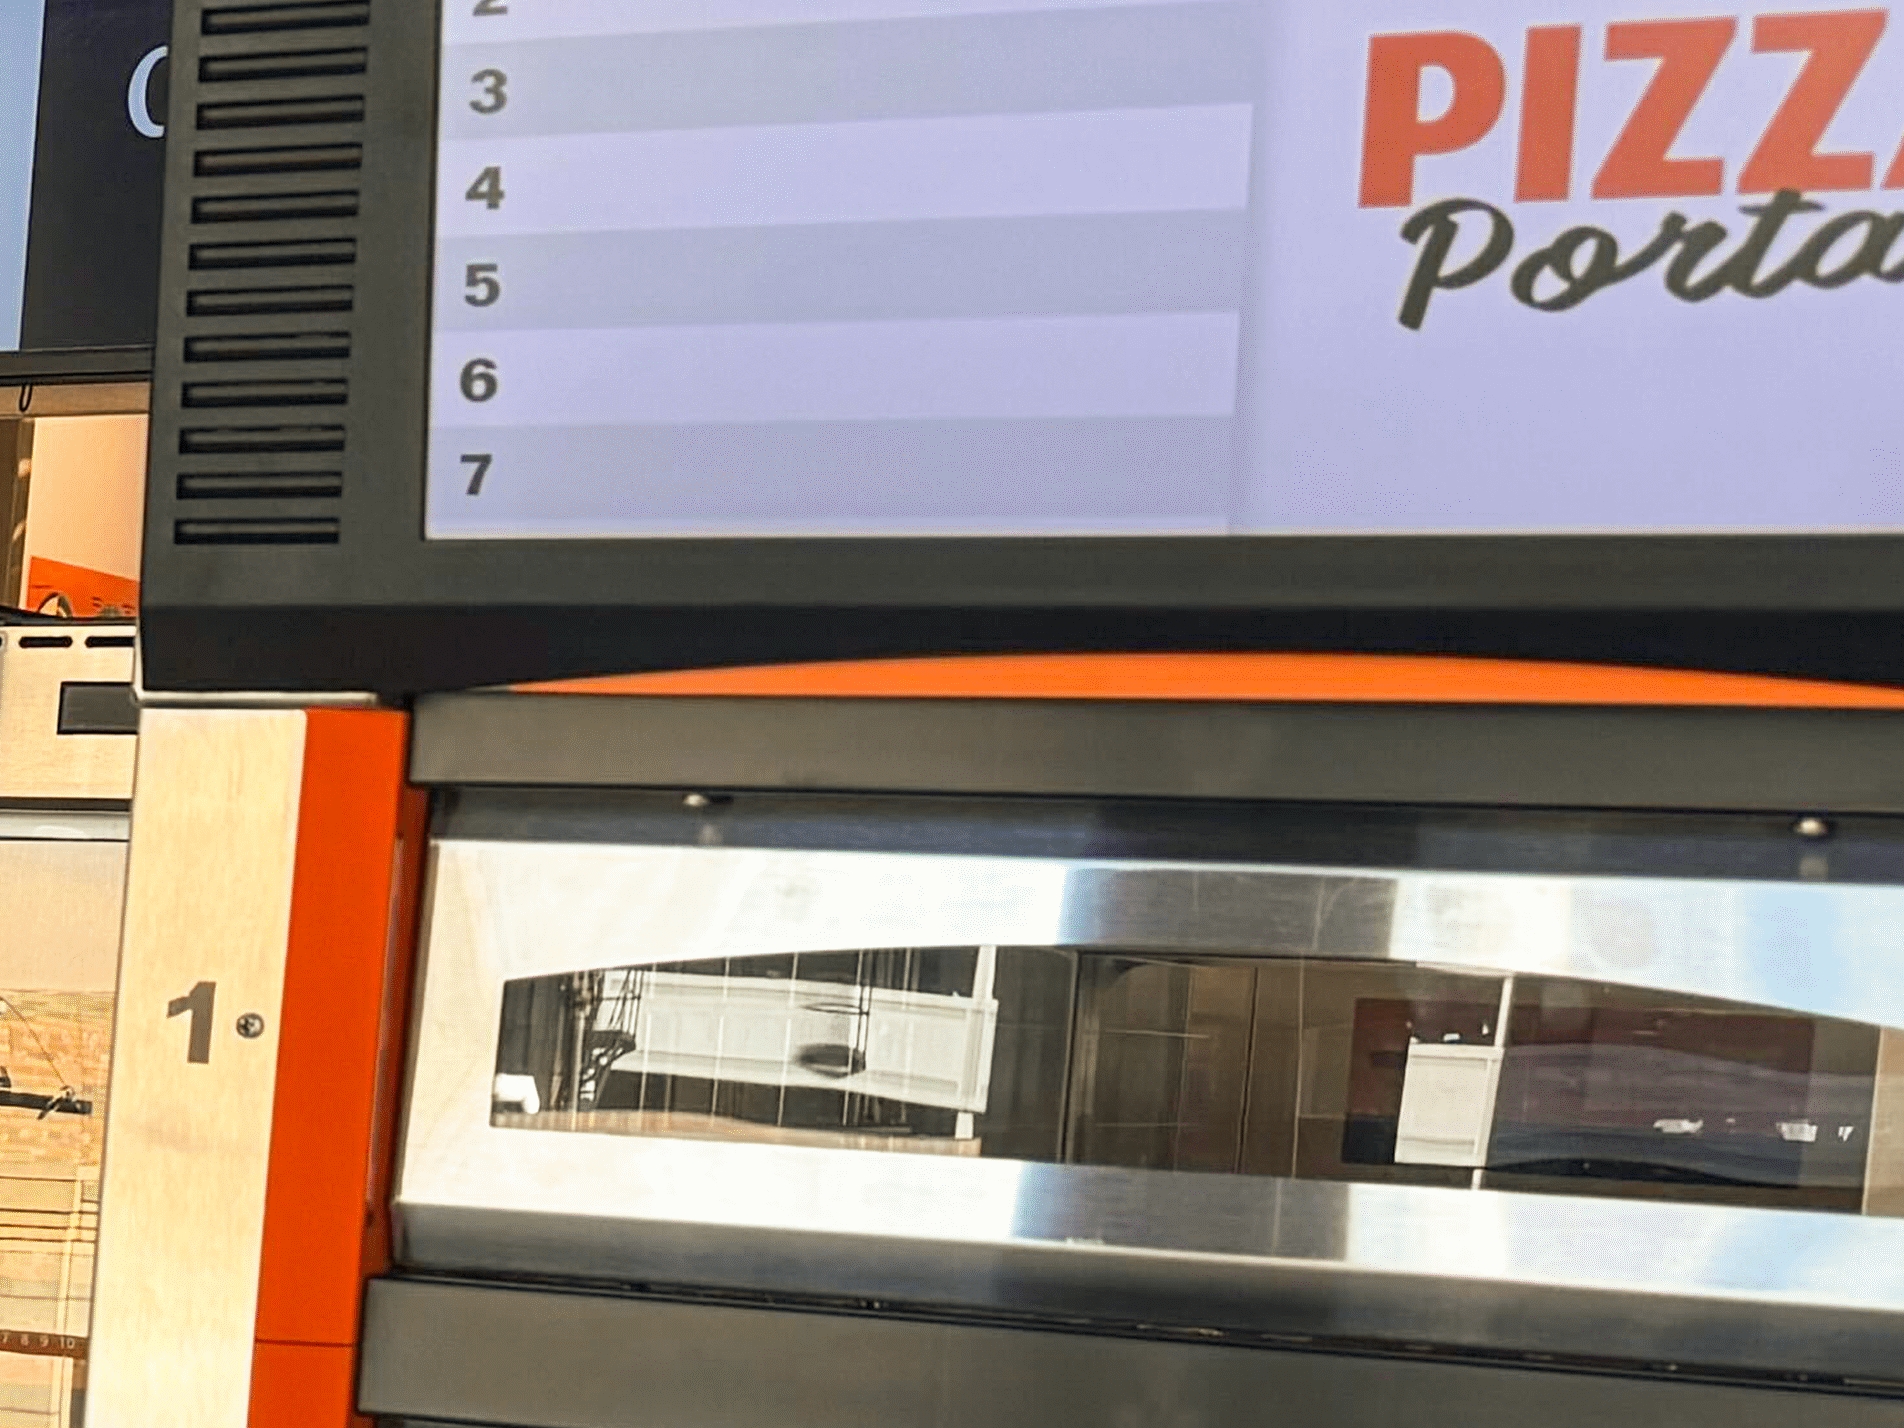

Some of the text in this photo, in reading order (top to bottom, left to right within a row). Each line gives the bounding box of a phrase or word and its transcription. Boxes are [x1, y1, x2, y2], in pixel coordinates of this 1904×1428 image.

[469, 68, 508, 115] 3
[1357, 7, 1904, 209] PIZZ
[464, 166, 505, 210] 4
[463, 262, 500, 307] 5
[459, 357, 498, 403] 6
[459, 453, 493, 496] 7
[166, 981, 216, 1064] 1
